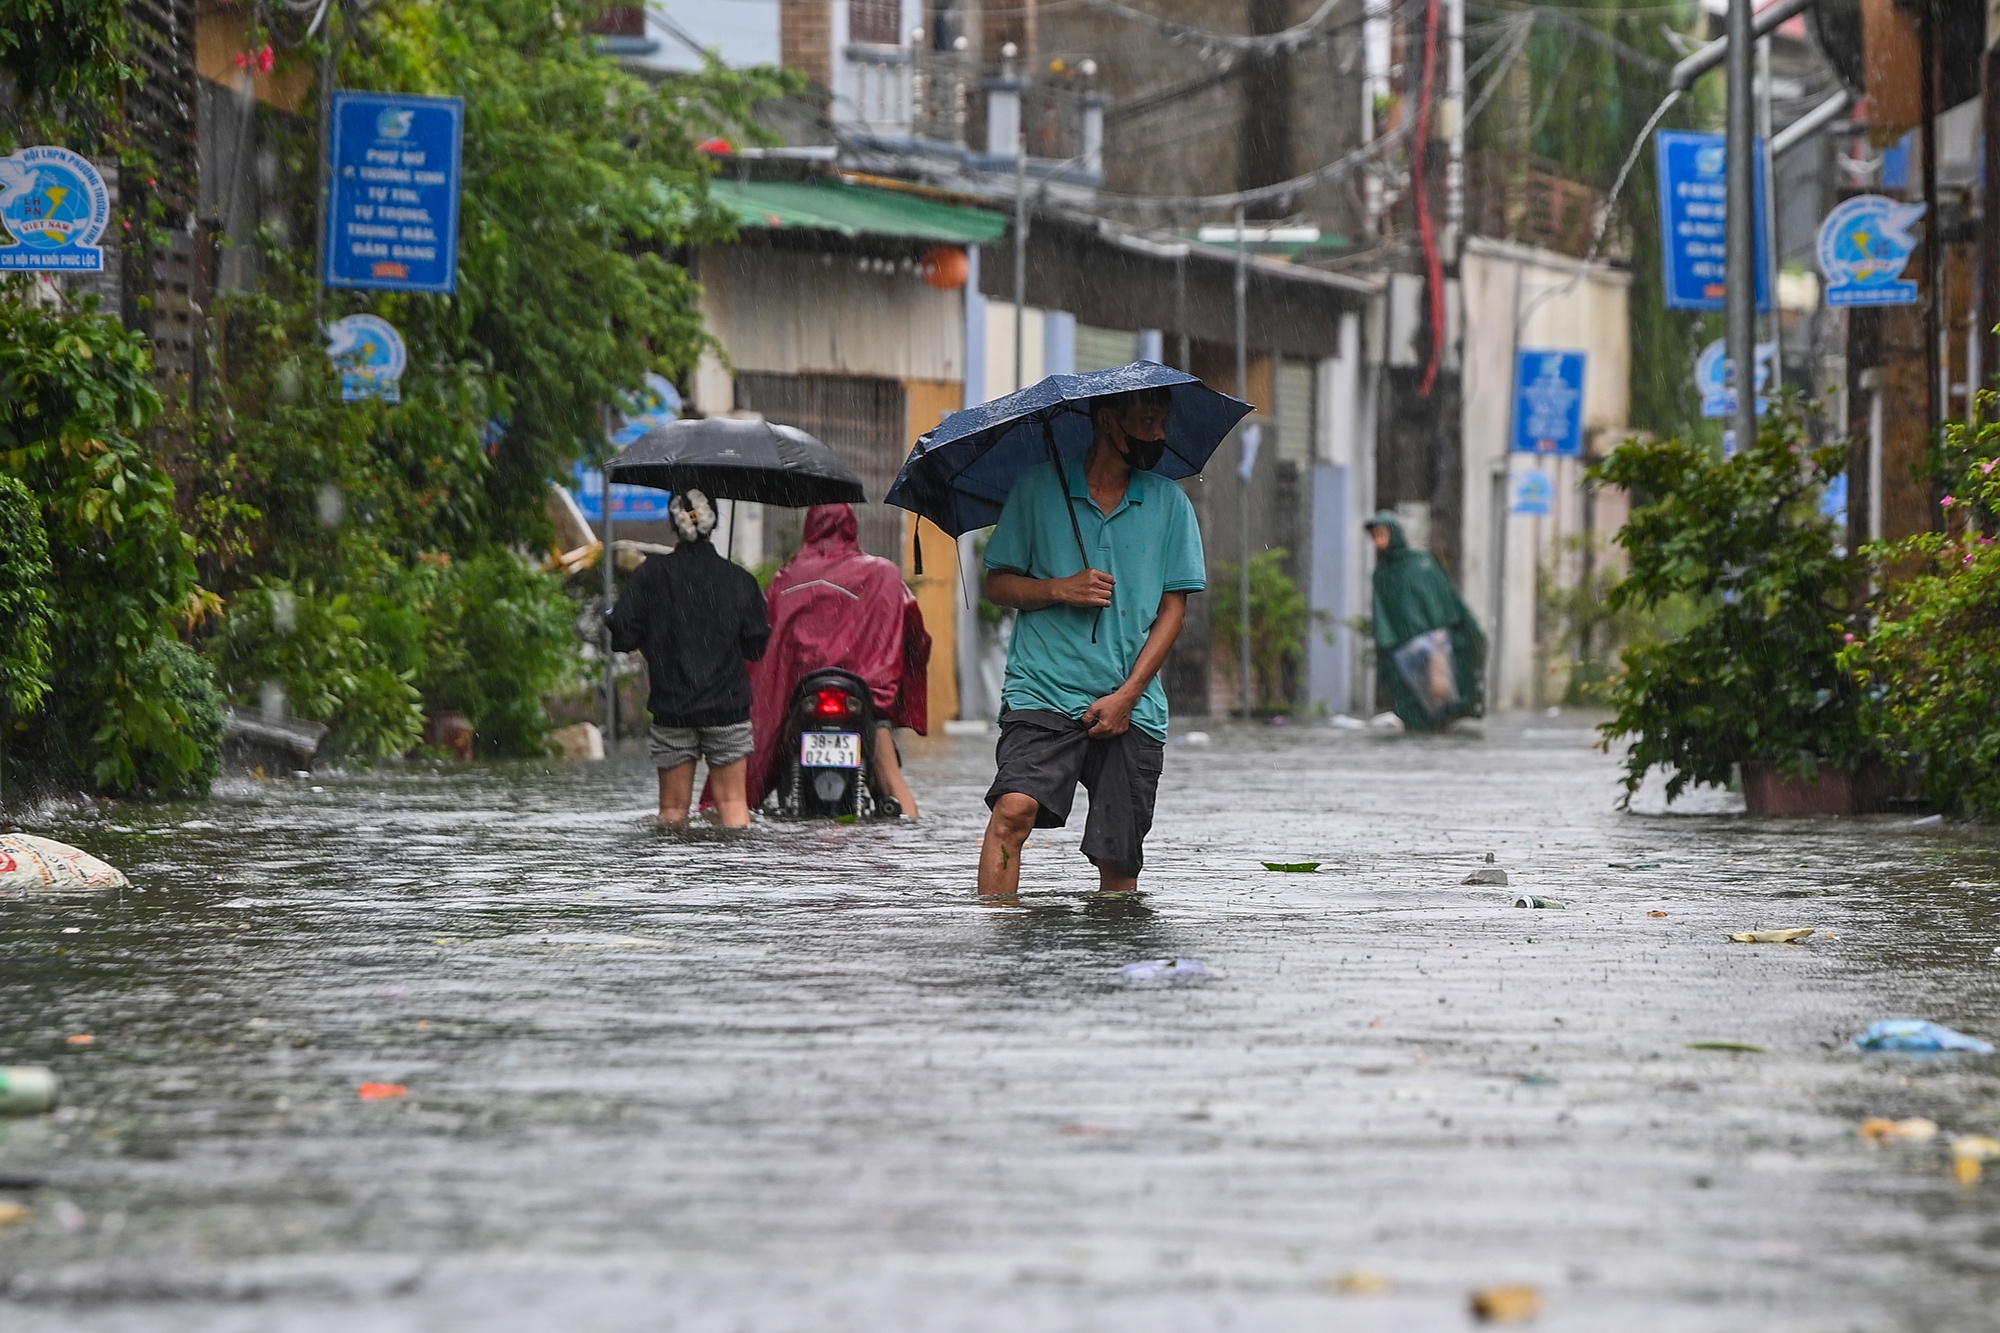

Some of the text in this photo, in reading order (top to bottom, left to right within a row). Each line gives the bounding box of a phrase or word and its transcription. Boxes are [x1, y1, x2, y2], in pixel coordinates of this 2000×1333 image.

[42, 149, 67, 160] LHPN
[82, 225, 100, 245] VINH
[48, 221, 70, 231] NAM
[806, 750, 854, 764] 024.31
